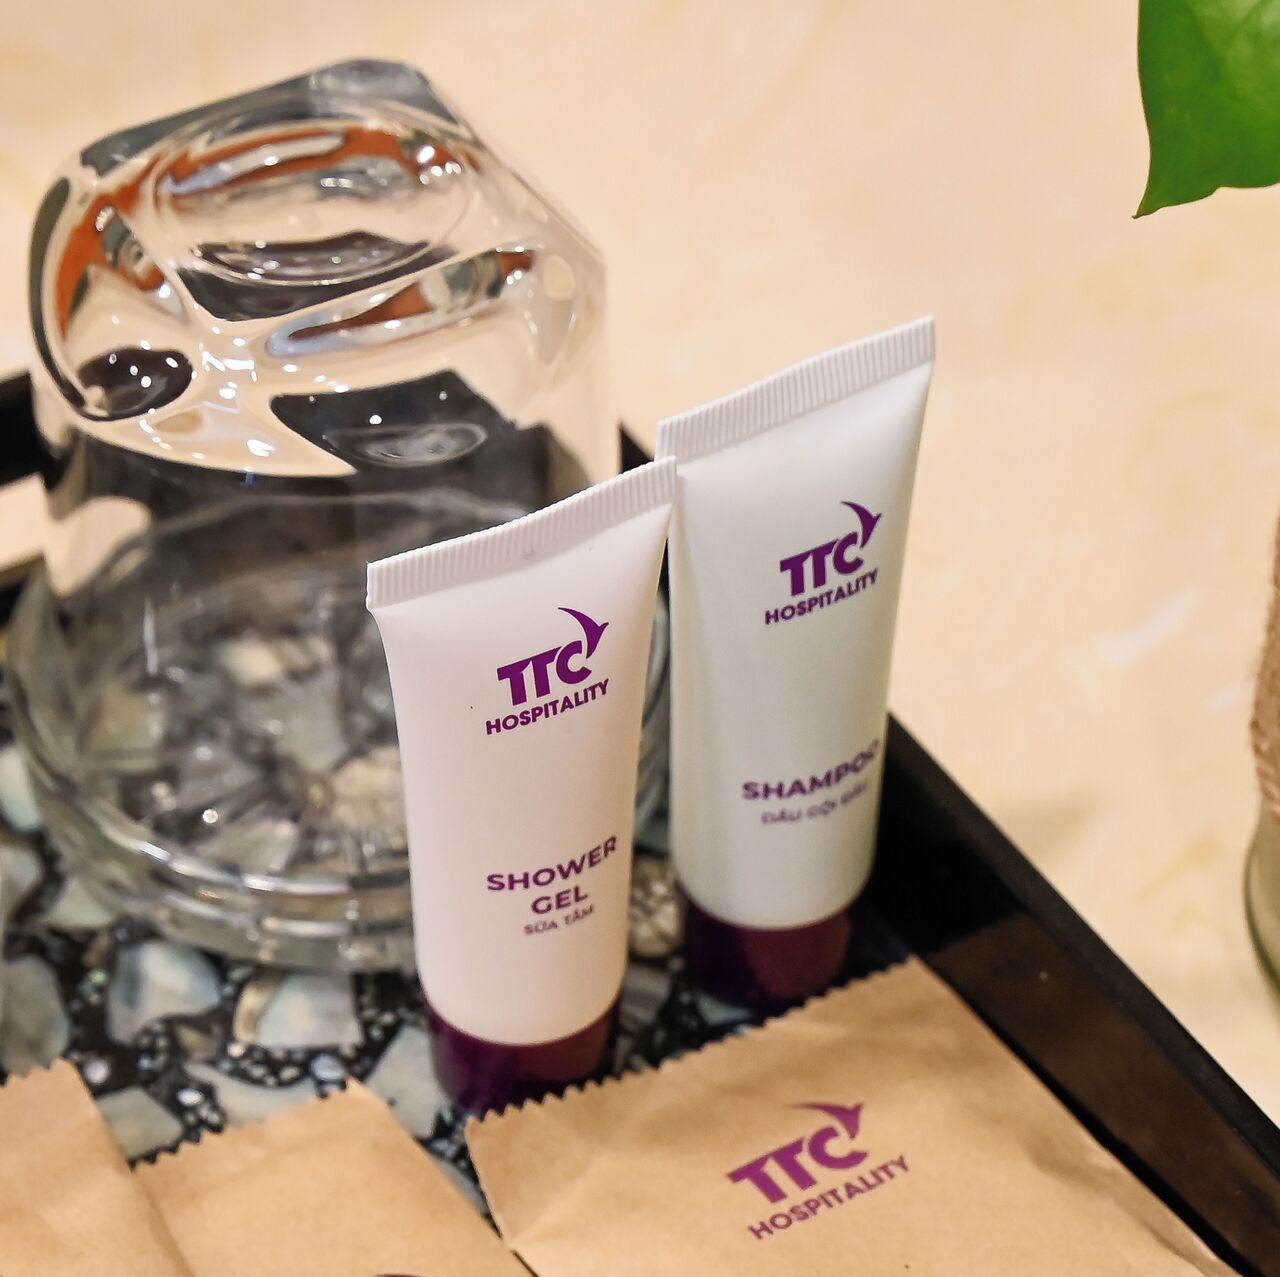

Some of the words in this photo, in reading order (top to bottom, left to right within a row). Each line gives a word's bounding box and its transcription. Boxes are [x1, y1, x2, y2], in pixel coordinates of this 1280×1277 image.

[779, 532, 864, 597] TTC
[764, 569, 879, 626] HOSPITALITY
[496, 640, 592, 705] TTC
[485, 677, 610, 735] HOSPITALITY
[486, 835, 617, 892] SHOWER
[531, 886, 589, 916] GEL
[727, 1127, 869, 1204] TTC
[748, 1154, 911, 1241] HOSPITALITY
